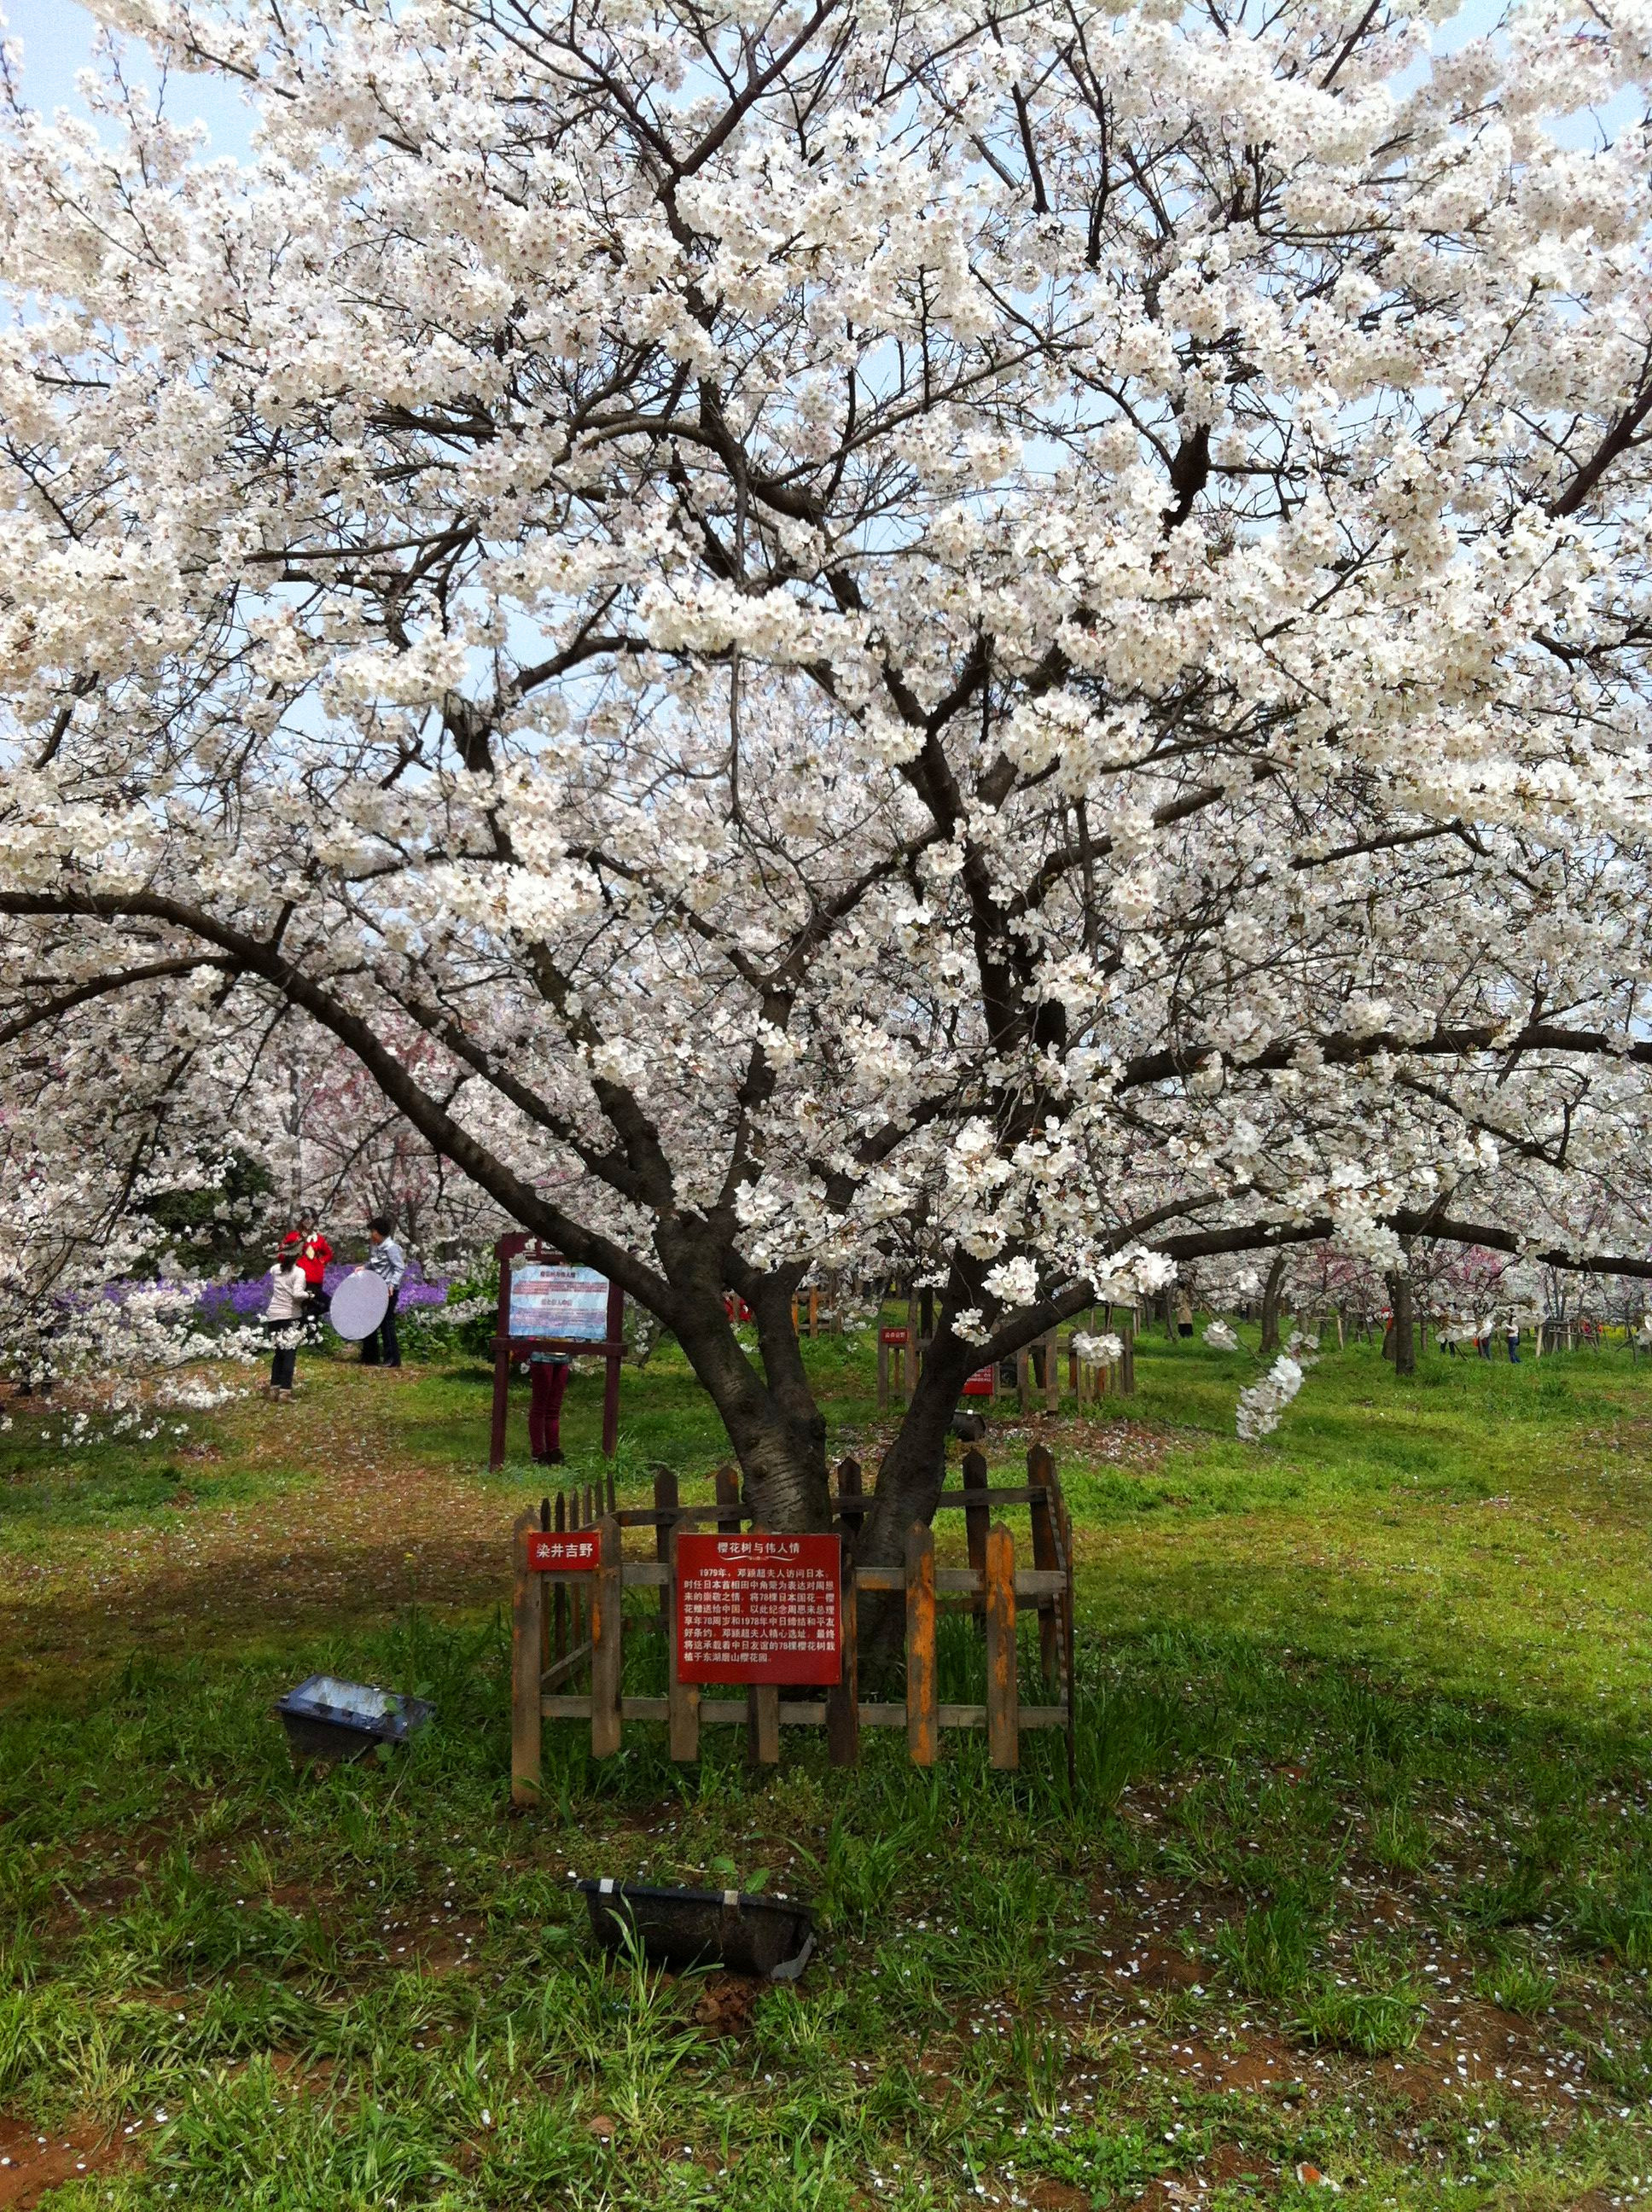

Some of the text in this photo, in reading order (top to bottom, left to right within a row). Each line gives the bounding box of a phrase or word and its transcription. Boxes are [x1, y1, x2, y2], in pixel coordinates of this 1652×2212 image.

[537, 1543, 593, 1558] 染井吉野
[717, 1542, 800, 1553] 樱花树与伟人情
